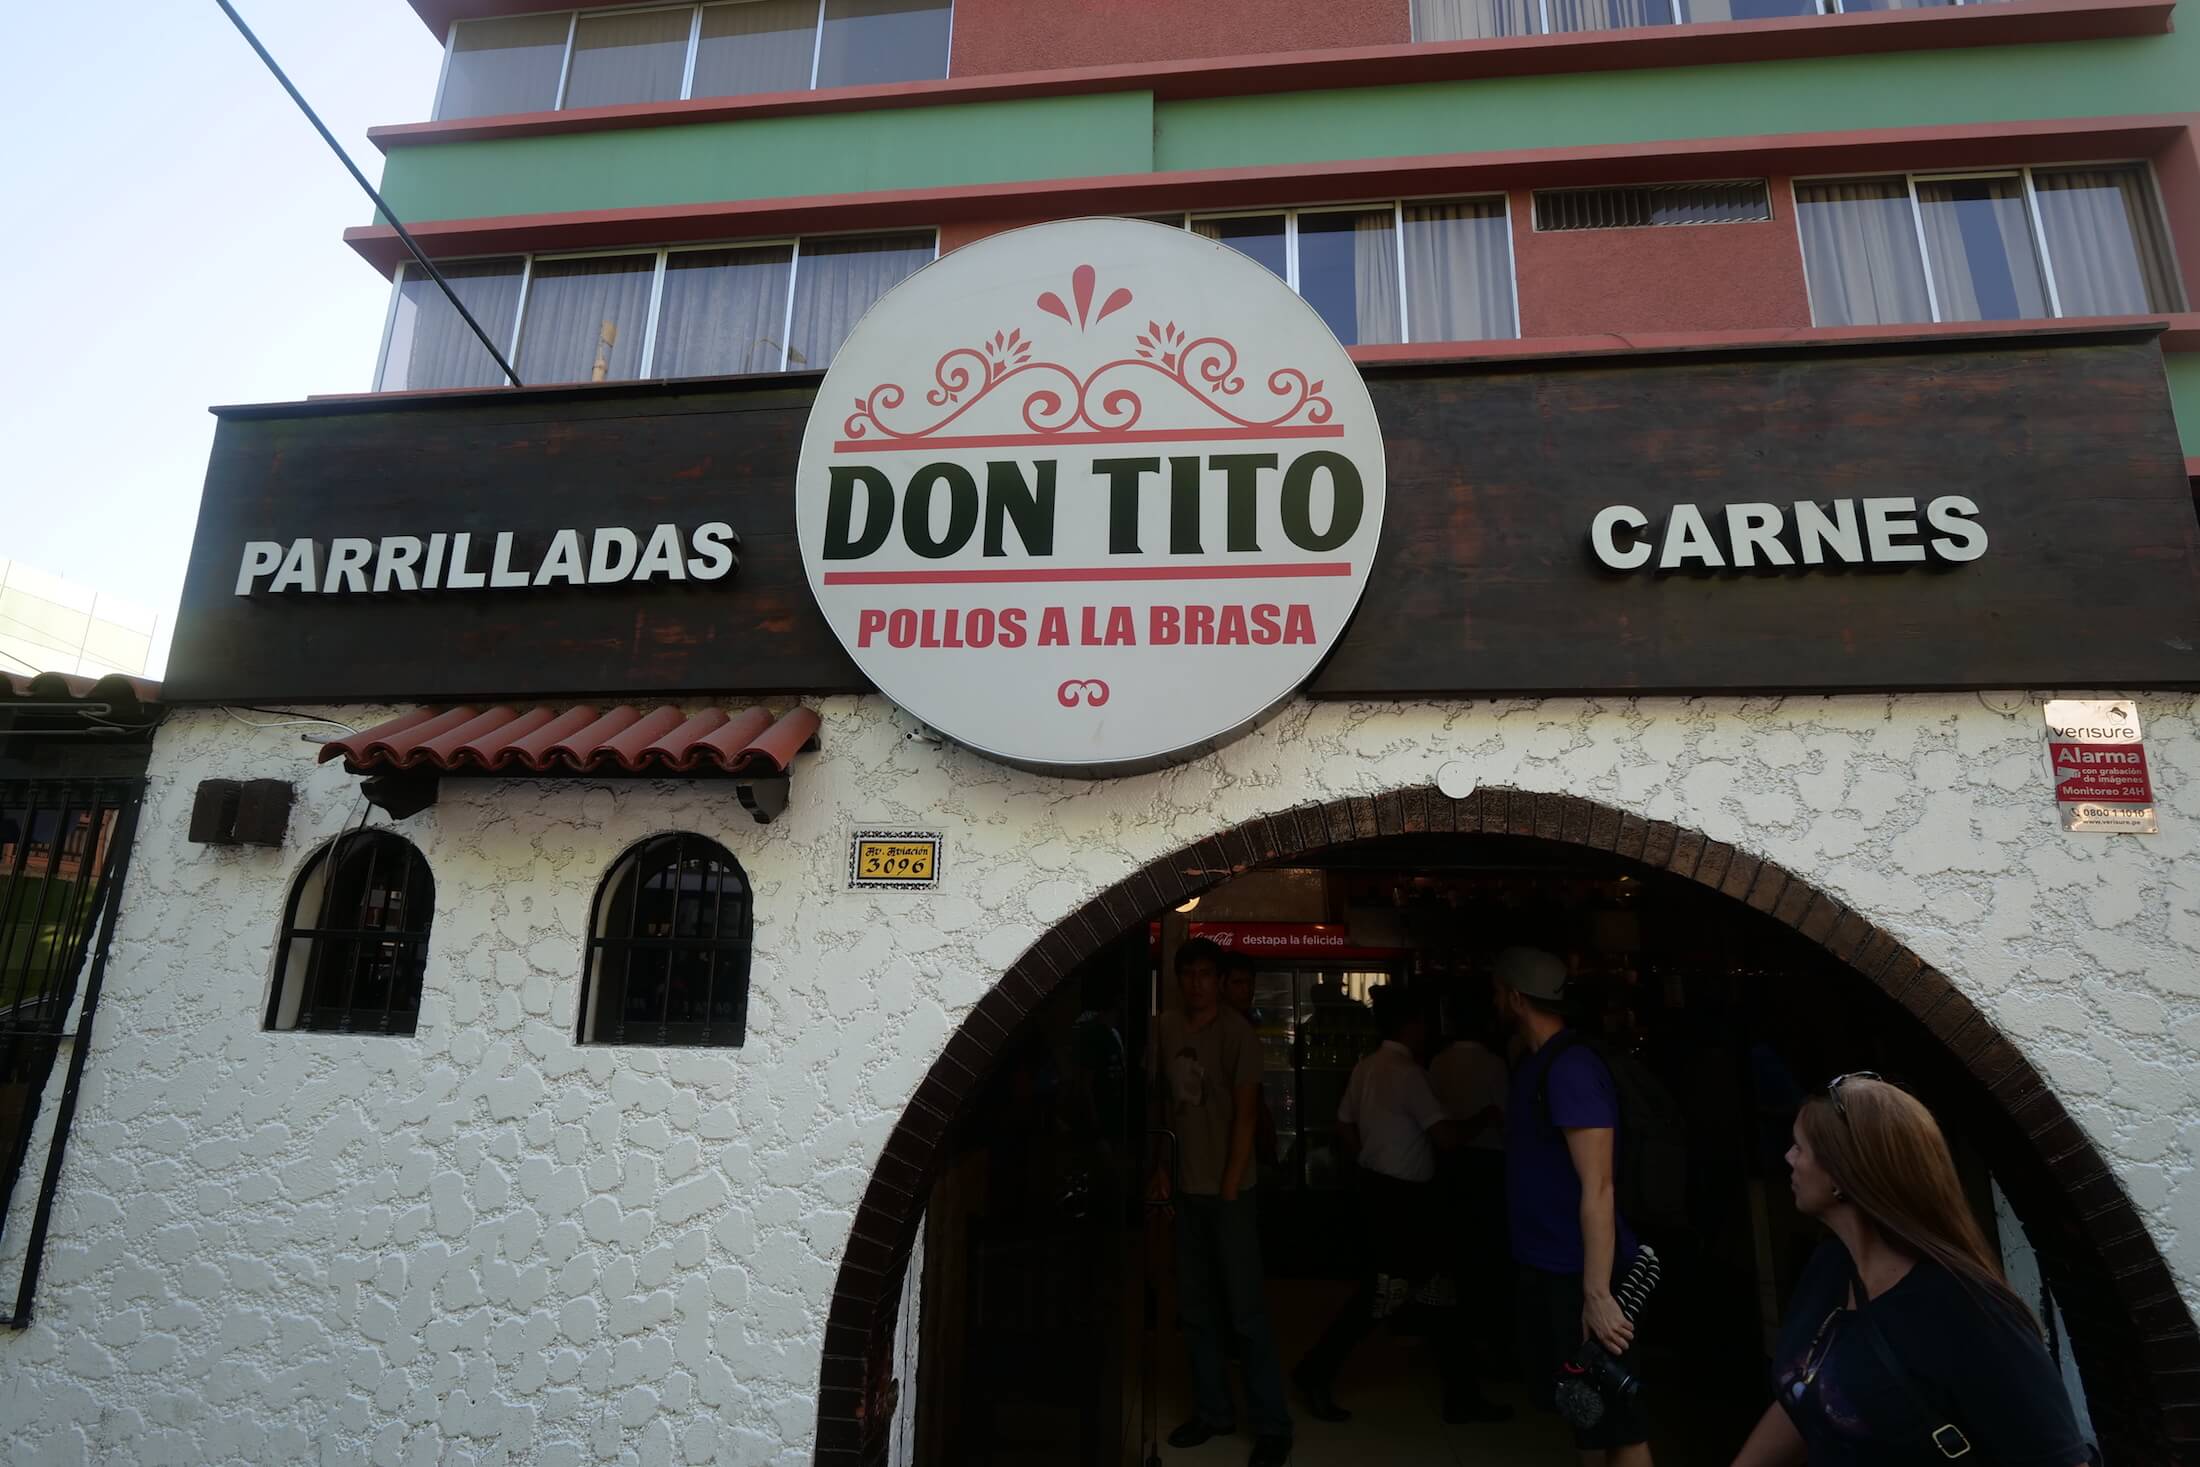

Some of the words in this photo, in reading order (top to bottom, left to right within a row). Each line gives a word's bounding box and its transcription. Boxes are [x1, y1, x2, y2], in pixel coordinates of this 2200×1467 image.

[822, 459, 1058, 561] DON
[1091, 450, 1364, 555] TITO
[1591, 496, 1989, 570] CARNES
[234, 521, 736, 596] PARRILLADAS
[857, 607, 1027, 648] POLLOS
[1036, 606, 1070, 647] A
[1079, 605, 1137, 646] LA
[1149, 603, 1317, 646] BRASA
[2053, 727, 2135, 739] verisure
[2057, 747, 2141, 764] Alarma
[2099, 767, 2142, 776] grabación
[2082, 775, 2096, 783] de
[2098, 775, 2144, 785] imágenes
[2063, 787, 2119, 796] Monitoreo
[2122, 787, 2145, 796] 24H
[2083, 808, 2109, 817] 0800
[865, 847, 885, 857] Av.
[865, 858, 926, 876] 3096
[1242, 933, 1287, 946] destapa
[1290, 934, 1300, 945] la
